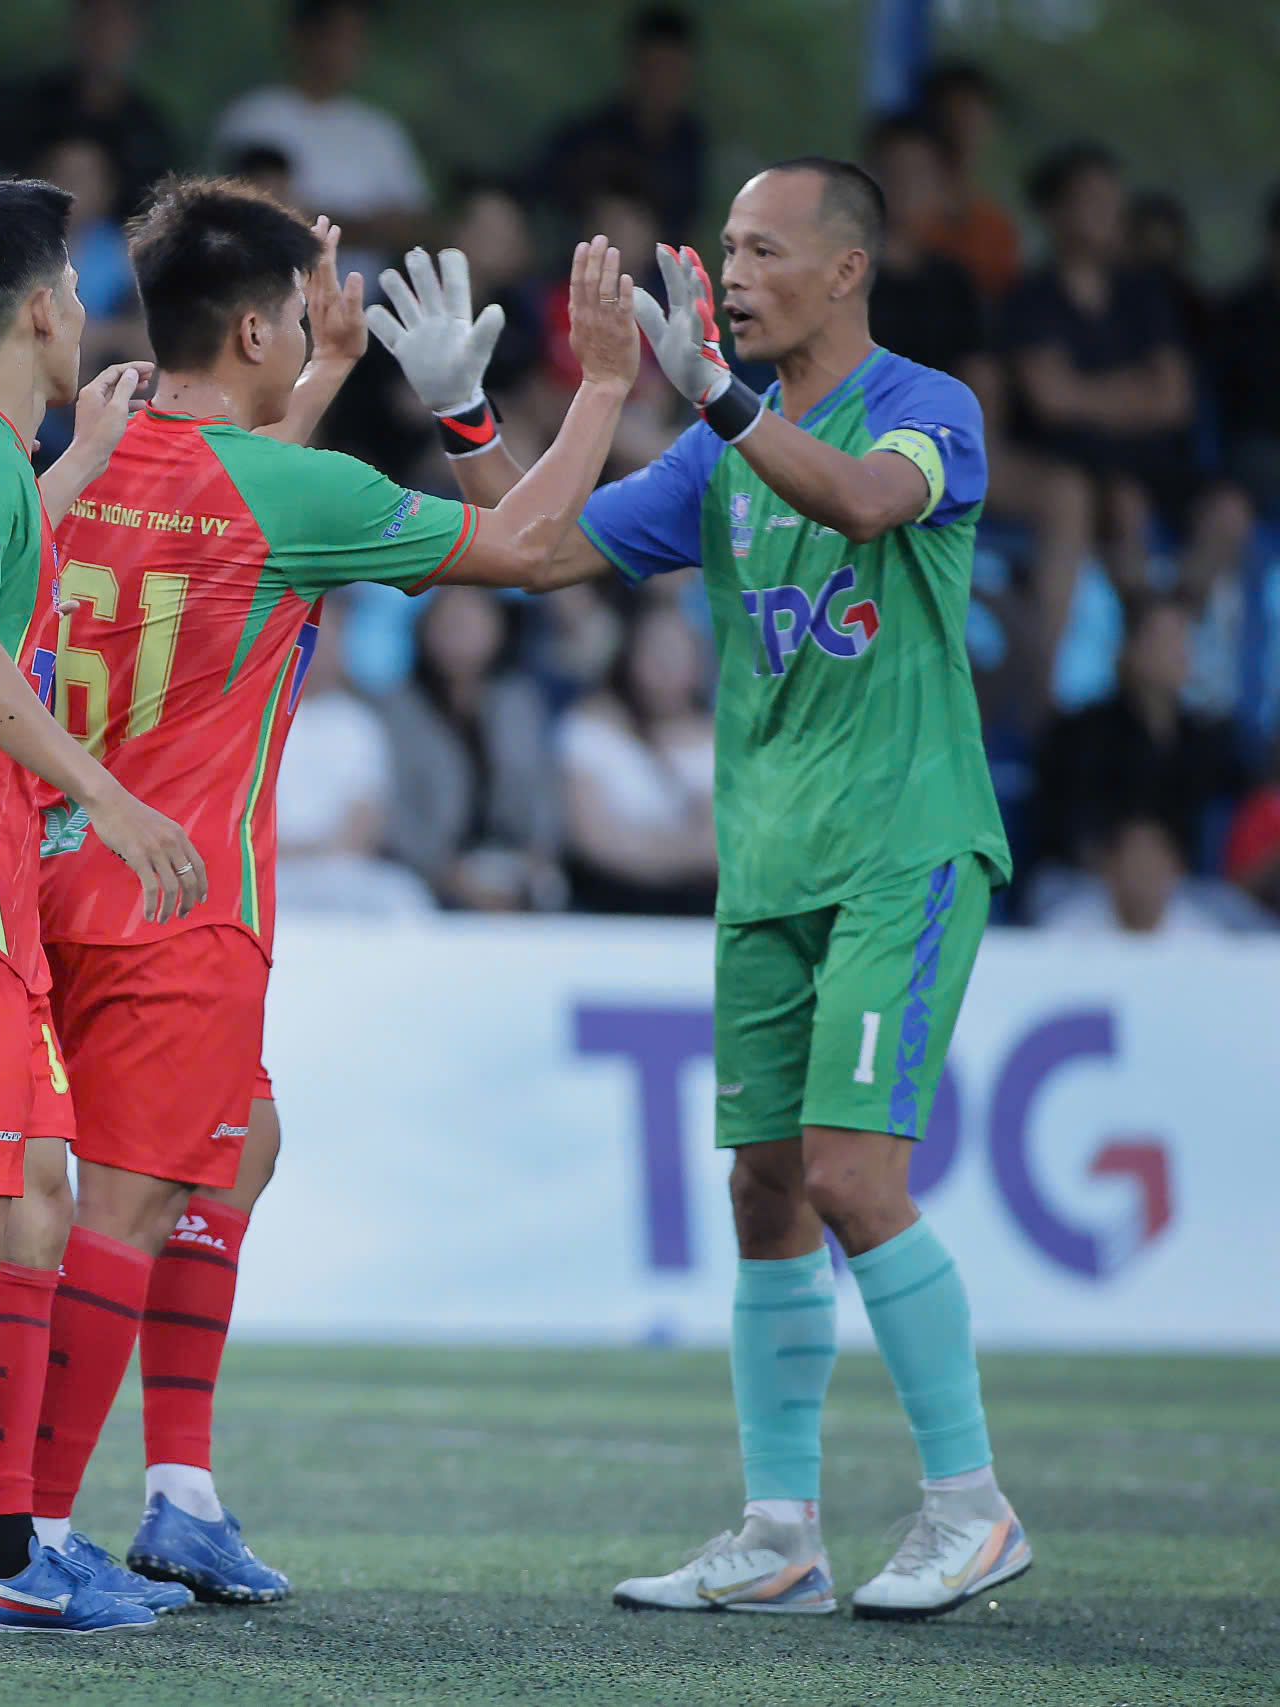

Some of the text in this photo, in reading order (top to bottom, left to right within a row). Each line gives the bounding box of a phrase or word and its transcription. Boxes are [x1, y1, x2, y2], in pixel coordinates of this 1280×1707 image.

[100, 502, 144, 528] NÔNG
[200, 516, 231, 537] VY
[381, 520, 403, 540] Ta
[55, 558, 191, 762] 61
[852, 1011, 881, 1084] 1
